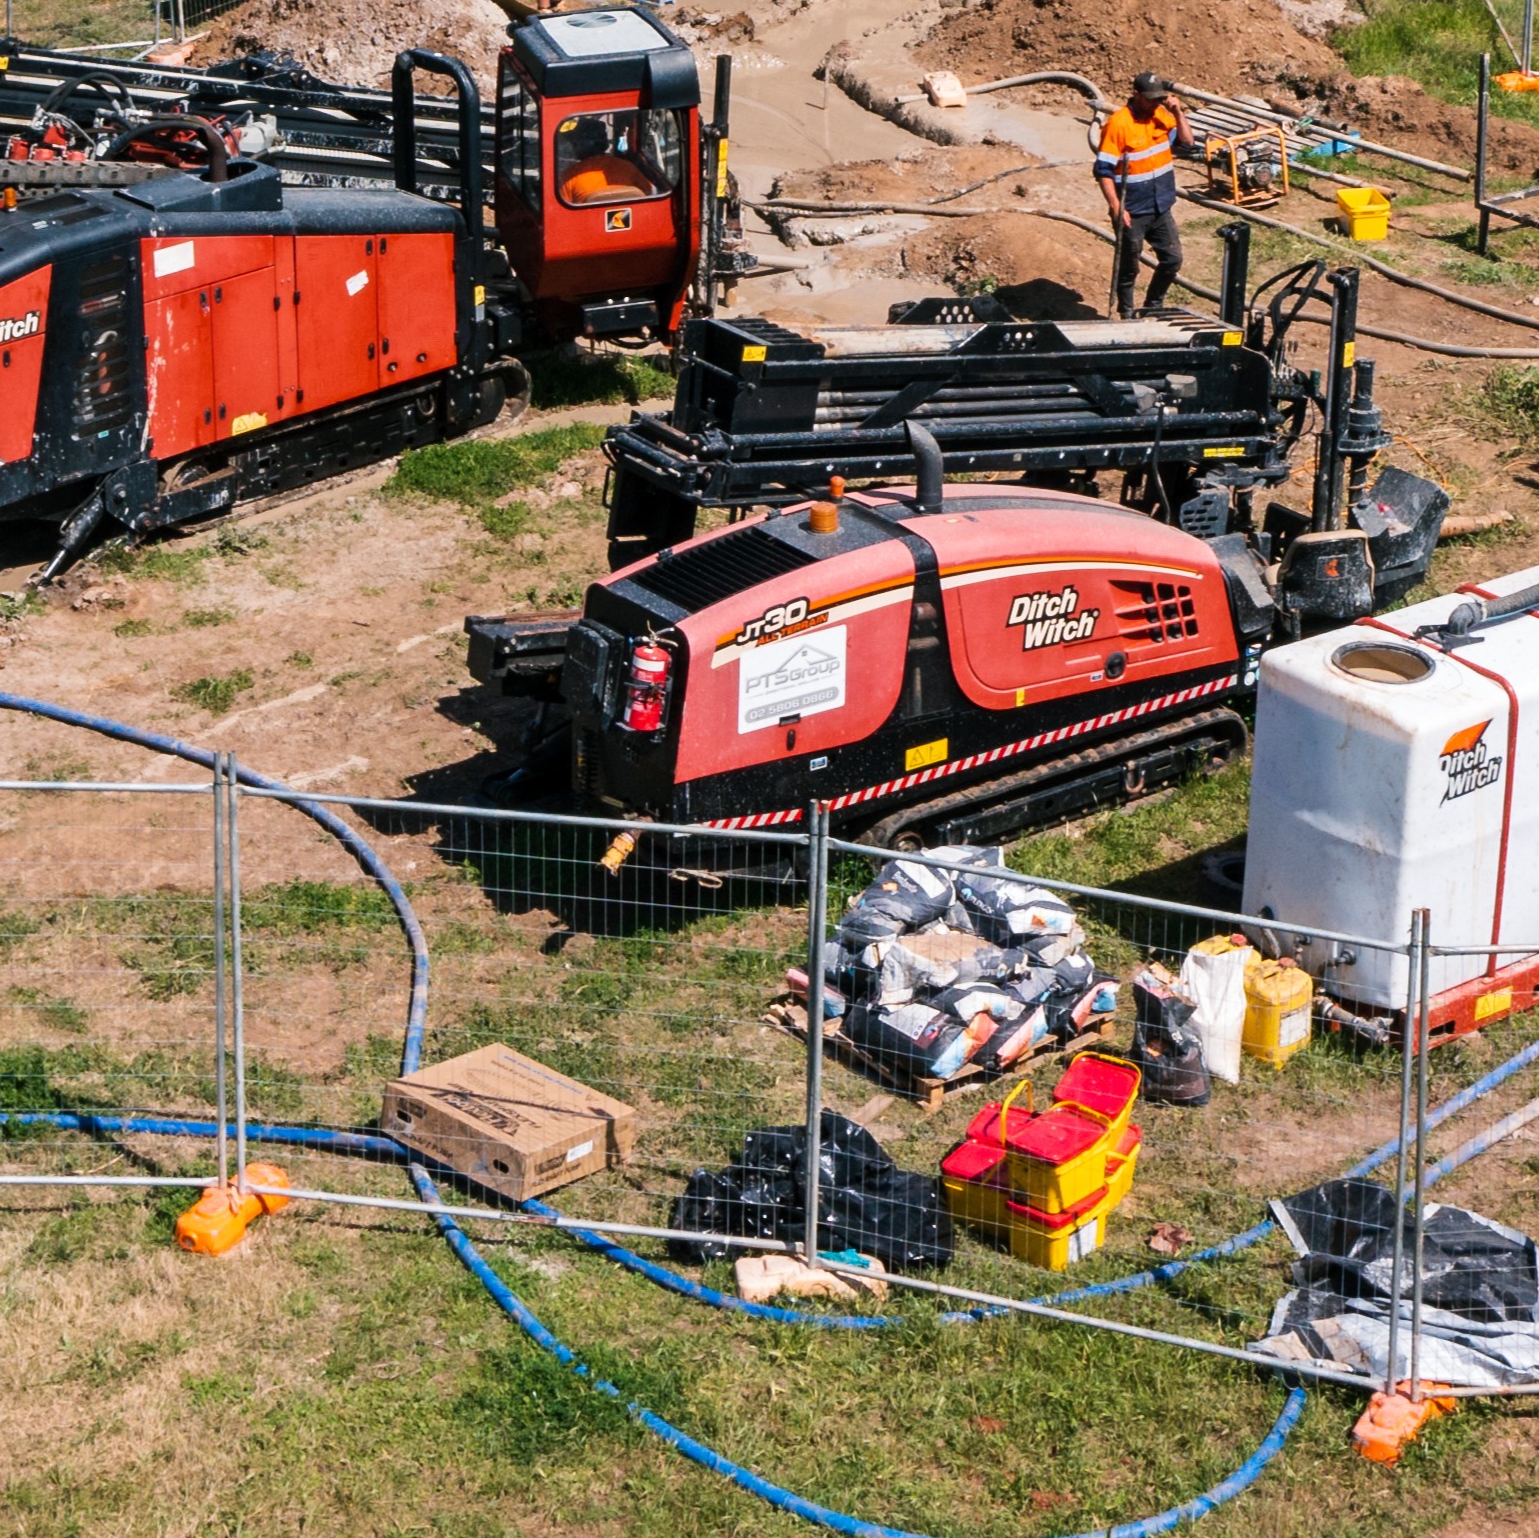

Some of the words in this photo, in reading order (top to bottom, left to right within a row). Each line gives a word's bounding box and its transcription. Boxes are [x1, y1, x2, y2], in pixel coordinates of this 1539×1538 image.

[737, 599, 808, 643] JT30
[1008, 587, 1078, 625] Ditch
[758, 633, 778, 646] ALL
[779, 613, 828, 638] TERRAIN
[1024, 611, 1096, 649] Witch
[749, 706, 766, 721] 02
[768, 700, 800, 716] 5806
[802, 690, 834, 705] 0866
[1439, 742, 1486, 775] Ditch
[1448, 759, 1500, 799] Witch
